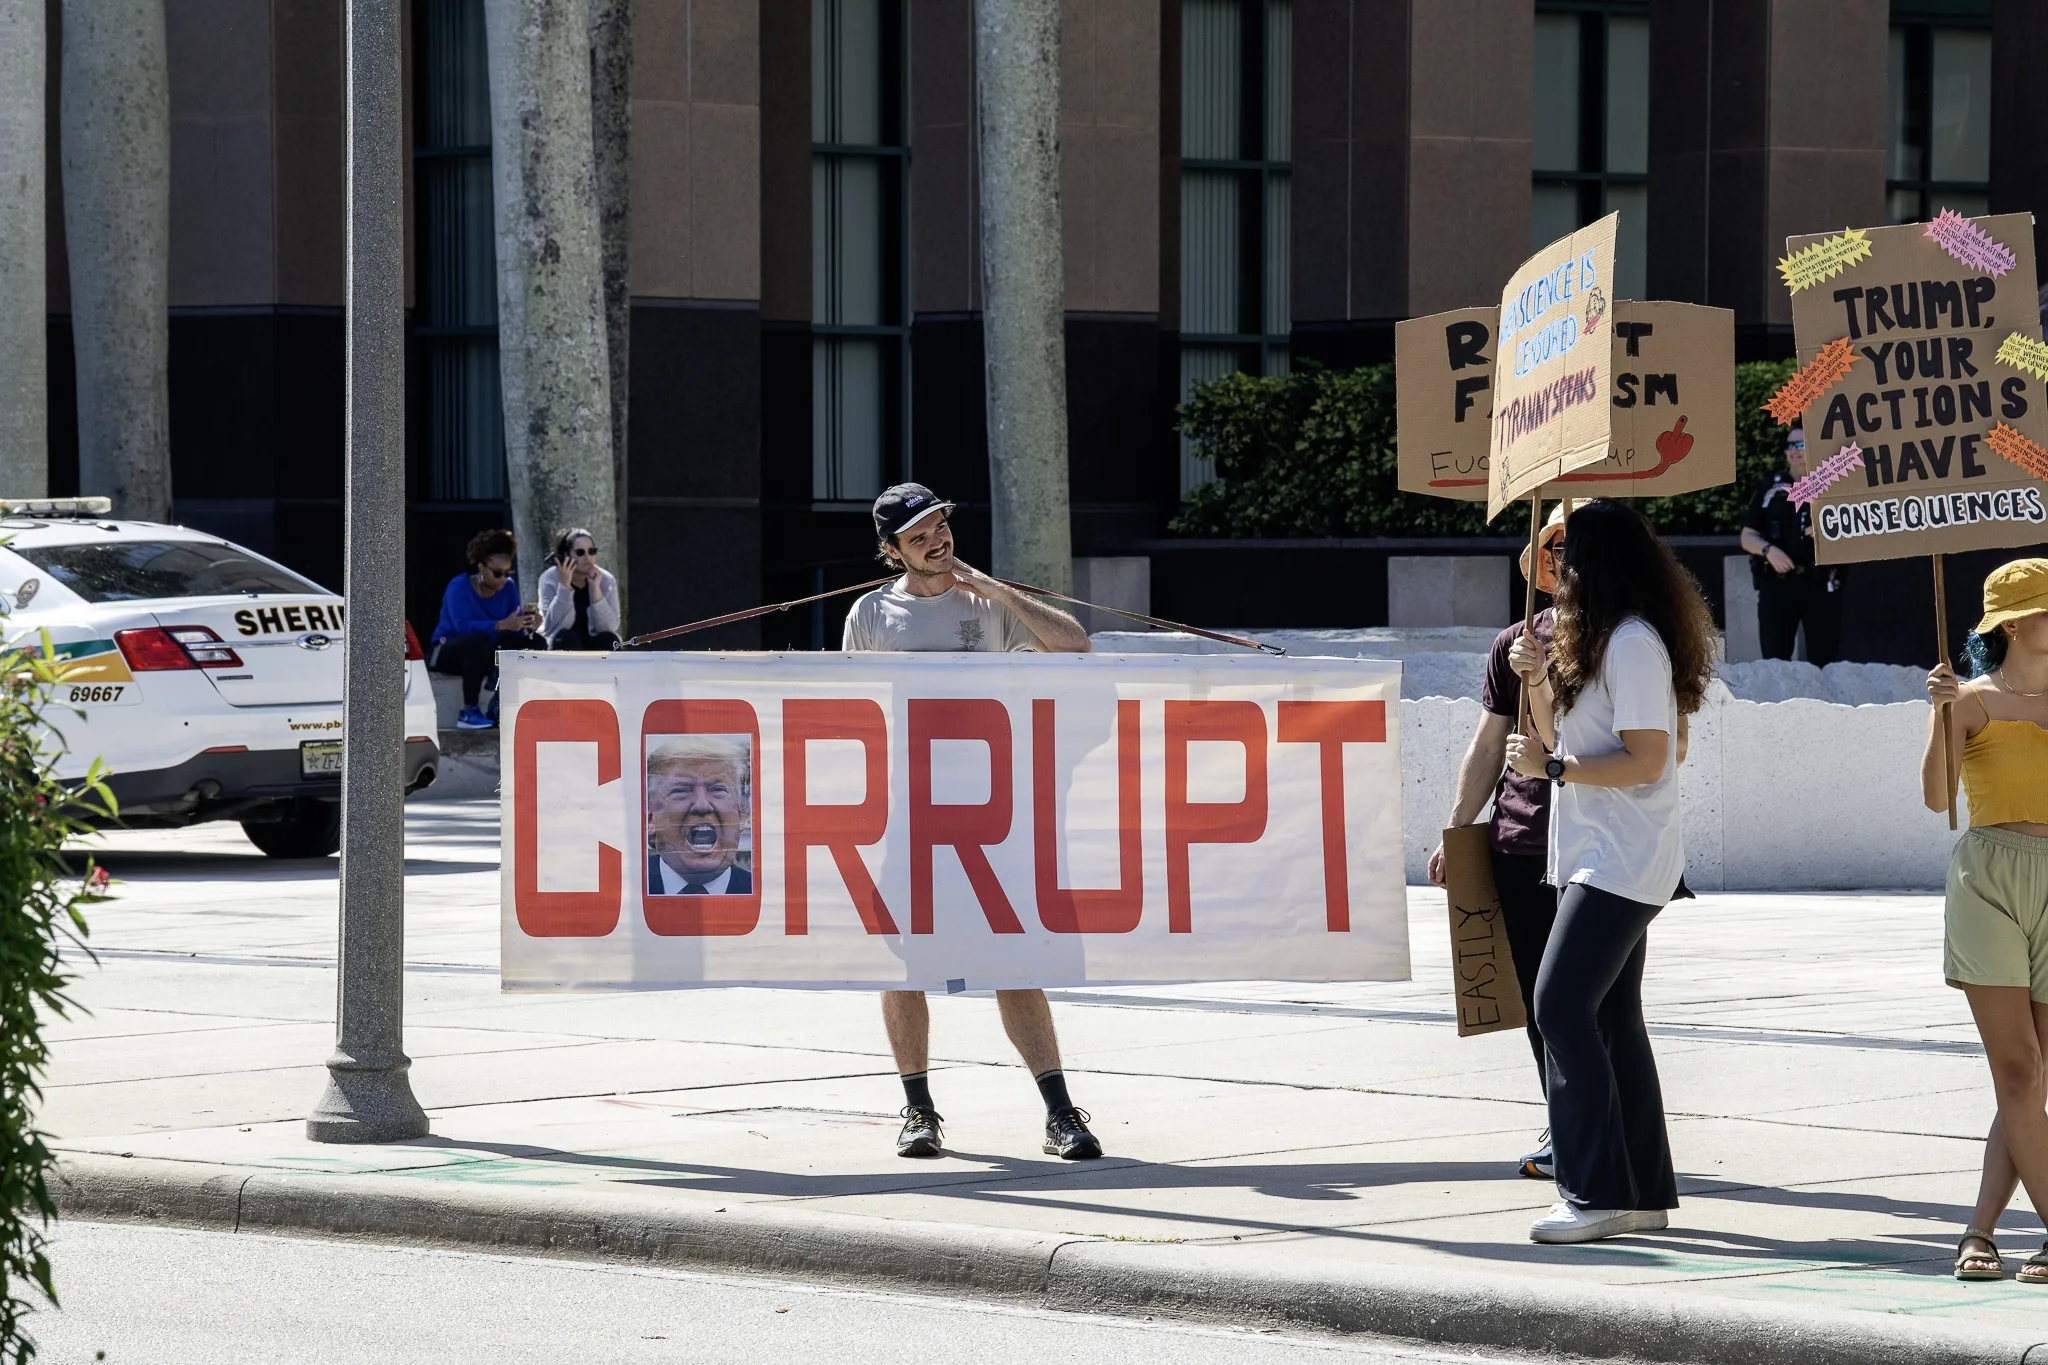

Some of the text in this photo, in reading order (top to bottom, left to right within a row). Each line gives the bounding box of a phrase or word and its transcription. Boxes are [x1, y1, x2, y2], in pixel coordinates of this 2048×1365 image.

[1788, 253, 1819, 271] OVERTURN
[1822, 245, 1833, 254] ROE
[1805, 242, 1865, 272] MATERNAL MORTALITY
[1932, 227, 1976, 263] RATES INCREASE
[1936, 222, 2002, 271] HEALTHCARE SUICIDE
[1942, 213, 2015, 269] REJECT GENDER-AFFIRMING
[1518, 257, 1575, 328] SCIENCE
[1579, 247, 1595, 292] IS
[1794, 261, 1841, 284] RATE INCREASES
[1833, 277, 1996, 340] TRUMP,
[1514, 313, 1578, 378] CENSORED
[1861, 337, 1978, 385] YOUR
[2016, 354, 2026, 363] FOR
[1769, 395, 1787, 412] DRAIN
[1799, 365, 1819, 383] GALLONS
[1818, 358, 1825, 366] OF
[1825, 341, 1841, 359] WATER
[1776, 406, 1789, 417] FOR
[1823, 347, 1846, 371] DROUGHT
[1783, 361, 1846, 421] THIS SUMMER INTENSIFIES
[1500, 382, 1552, 455] TYRANNY
[1551, 366, 1596, 419] SPEAKS
[1820, 377, 2028, 440] ACTIONS
[1430, 451, 1489, 479] FUC
[1835, 447, 1858, 463] EDUCATION
[1862, 434, 1986, 487] HAVE
[1994, 433, 2007, 443] GUN
[2009, 442, 2034, 460] VIOLENCE
[1820, 487, 2046, 540] CONSEQUENCES
[70, 686, 124, 702] 69667
[514, 698, 1386, 938] CORRUPT
[1455, 906, 1500, 1028] EASILY
